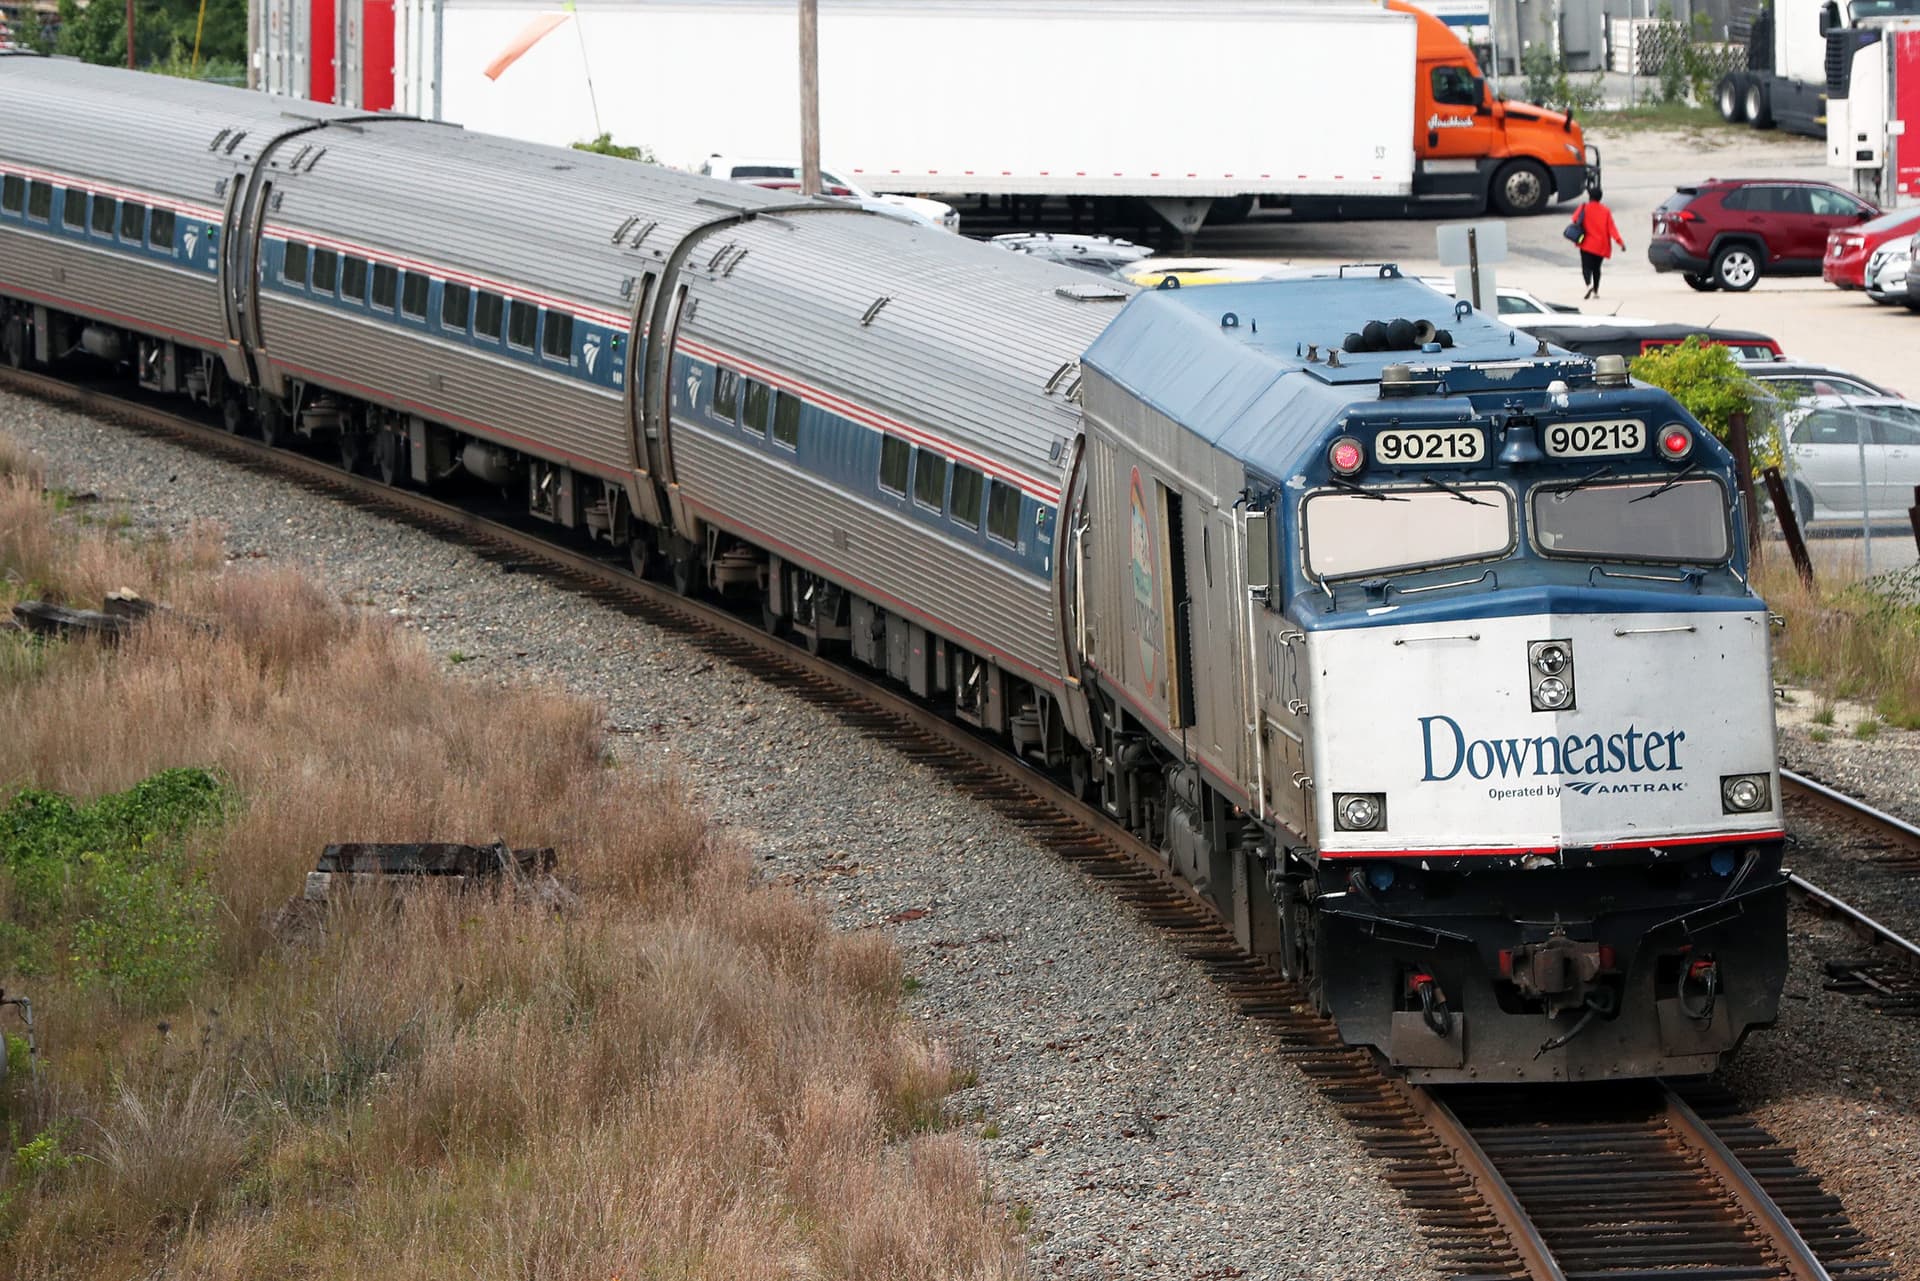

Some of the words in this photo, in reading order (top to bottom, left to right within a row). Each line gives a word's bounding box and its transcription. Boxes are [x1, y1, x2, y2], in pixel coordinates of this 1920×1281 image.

[1382, 433, 1477, 460] 90213
[1551, 423, 1639, 453] 90213
[1417, 714, 1686, 782] Downeaster
[1488, 785, 1543, 800] Operated
[1546, 785, 1561, 799] by
